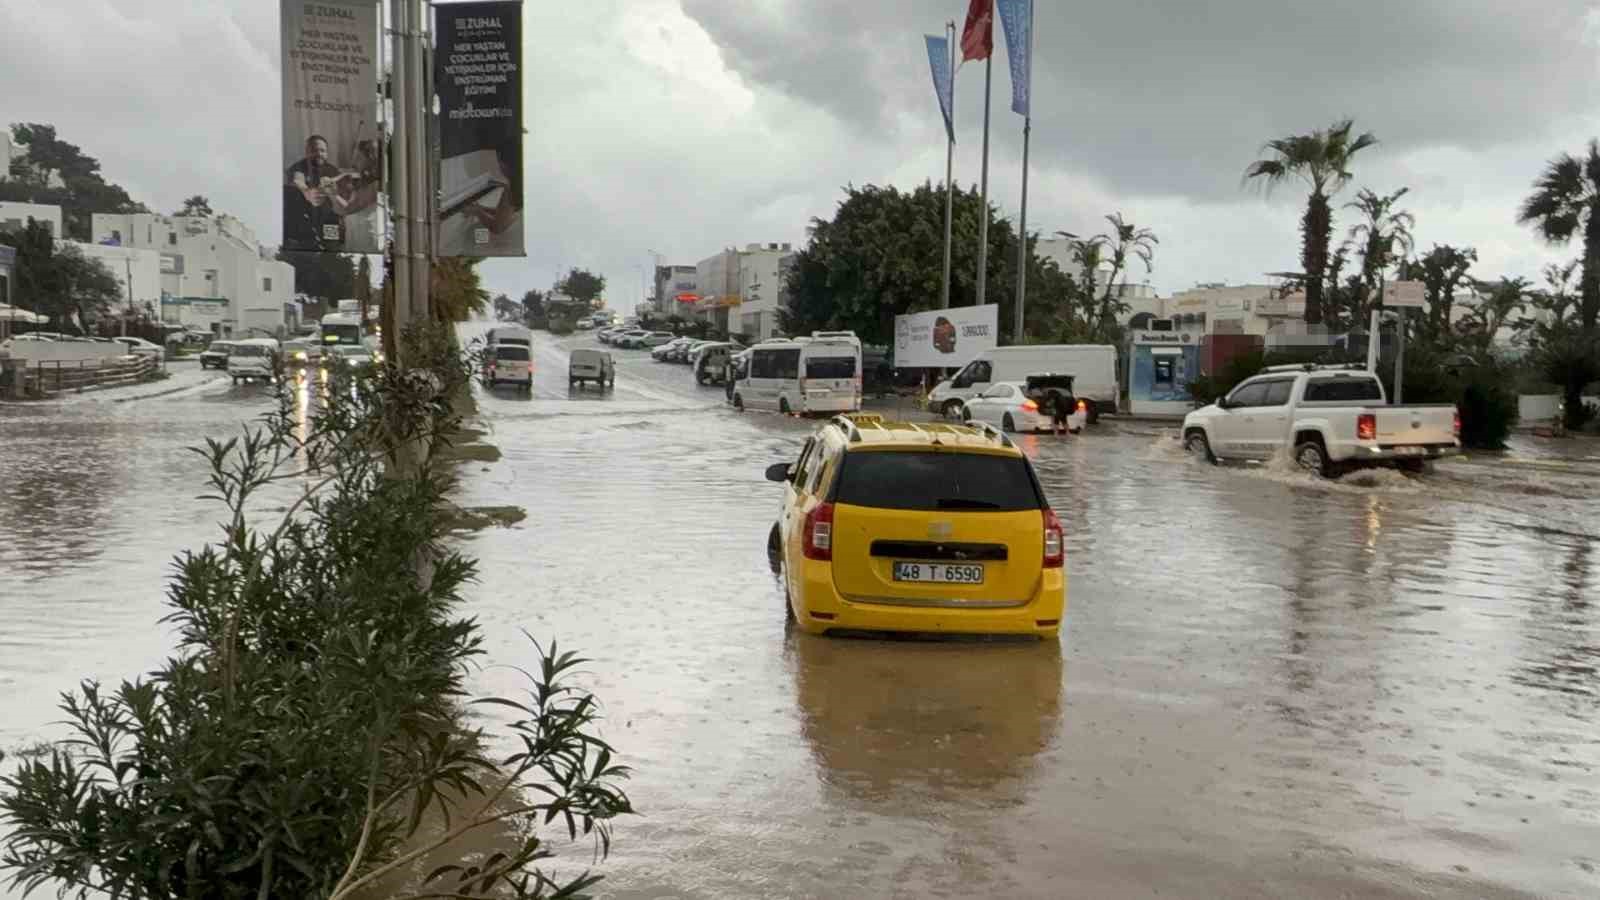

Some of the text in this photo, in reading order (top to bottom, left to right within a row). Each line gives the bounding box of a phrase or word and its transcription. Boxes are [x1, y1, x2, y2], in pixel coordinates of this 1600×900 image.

[317, 6, 356, 20] ZUHAL
[467, 16, 503, 29] ZUHAL
[454, 42, 472, 52] HER
[499, 51, 510, 61] VE
[902, 564, 981, 581] 48 T 6590
